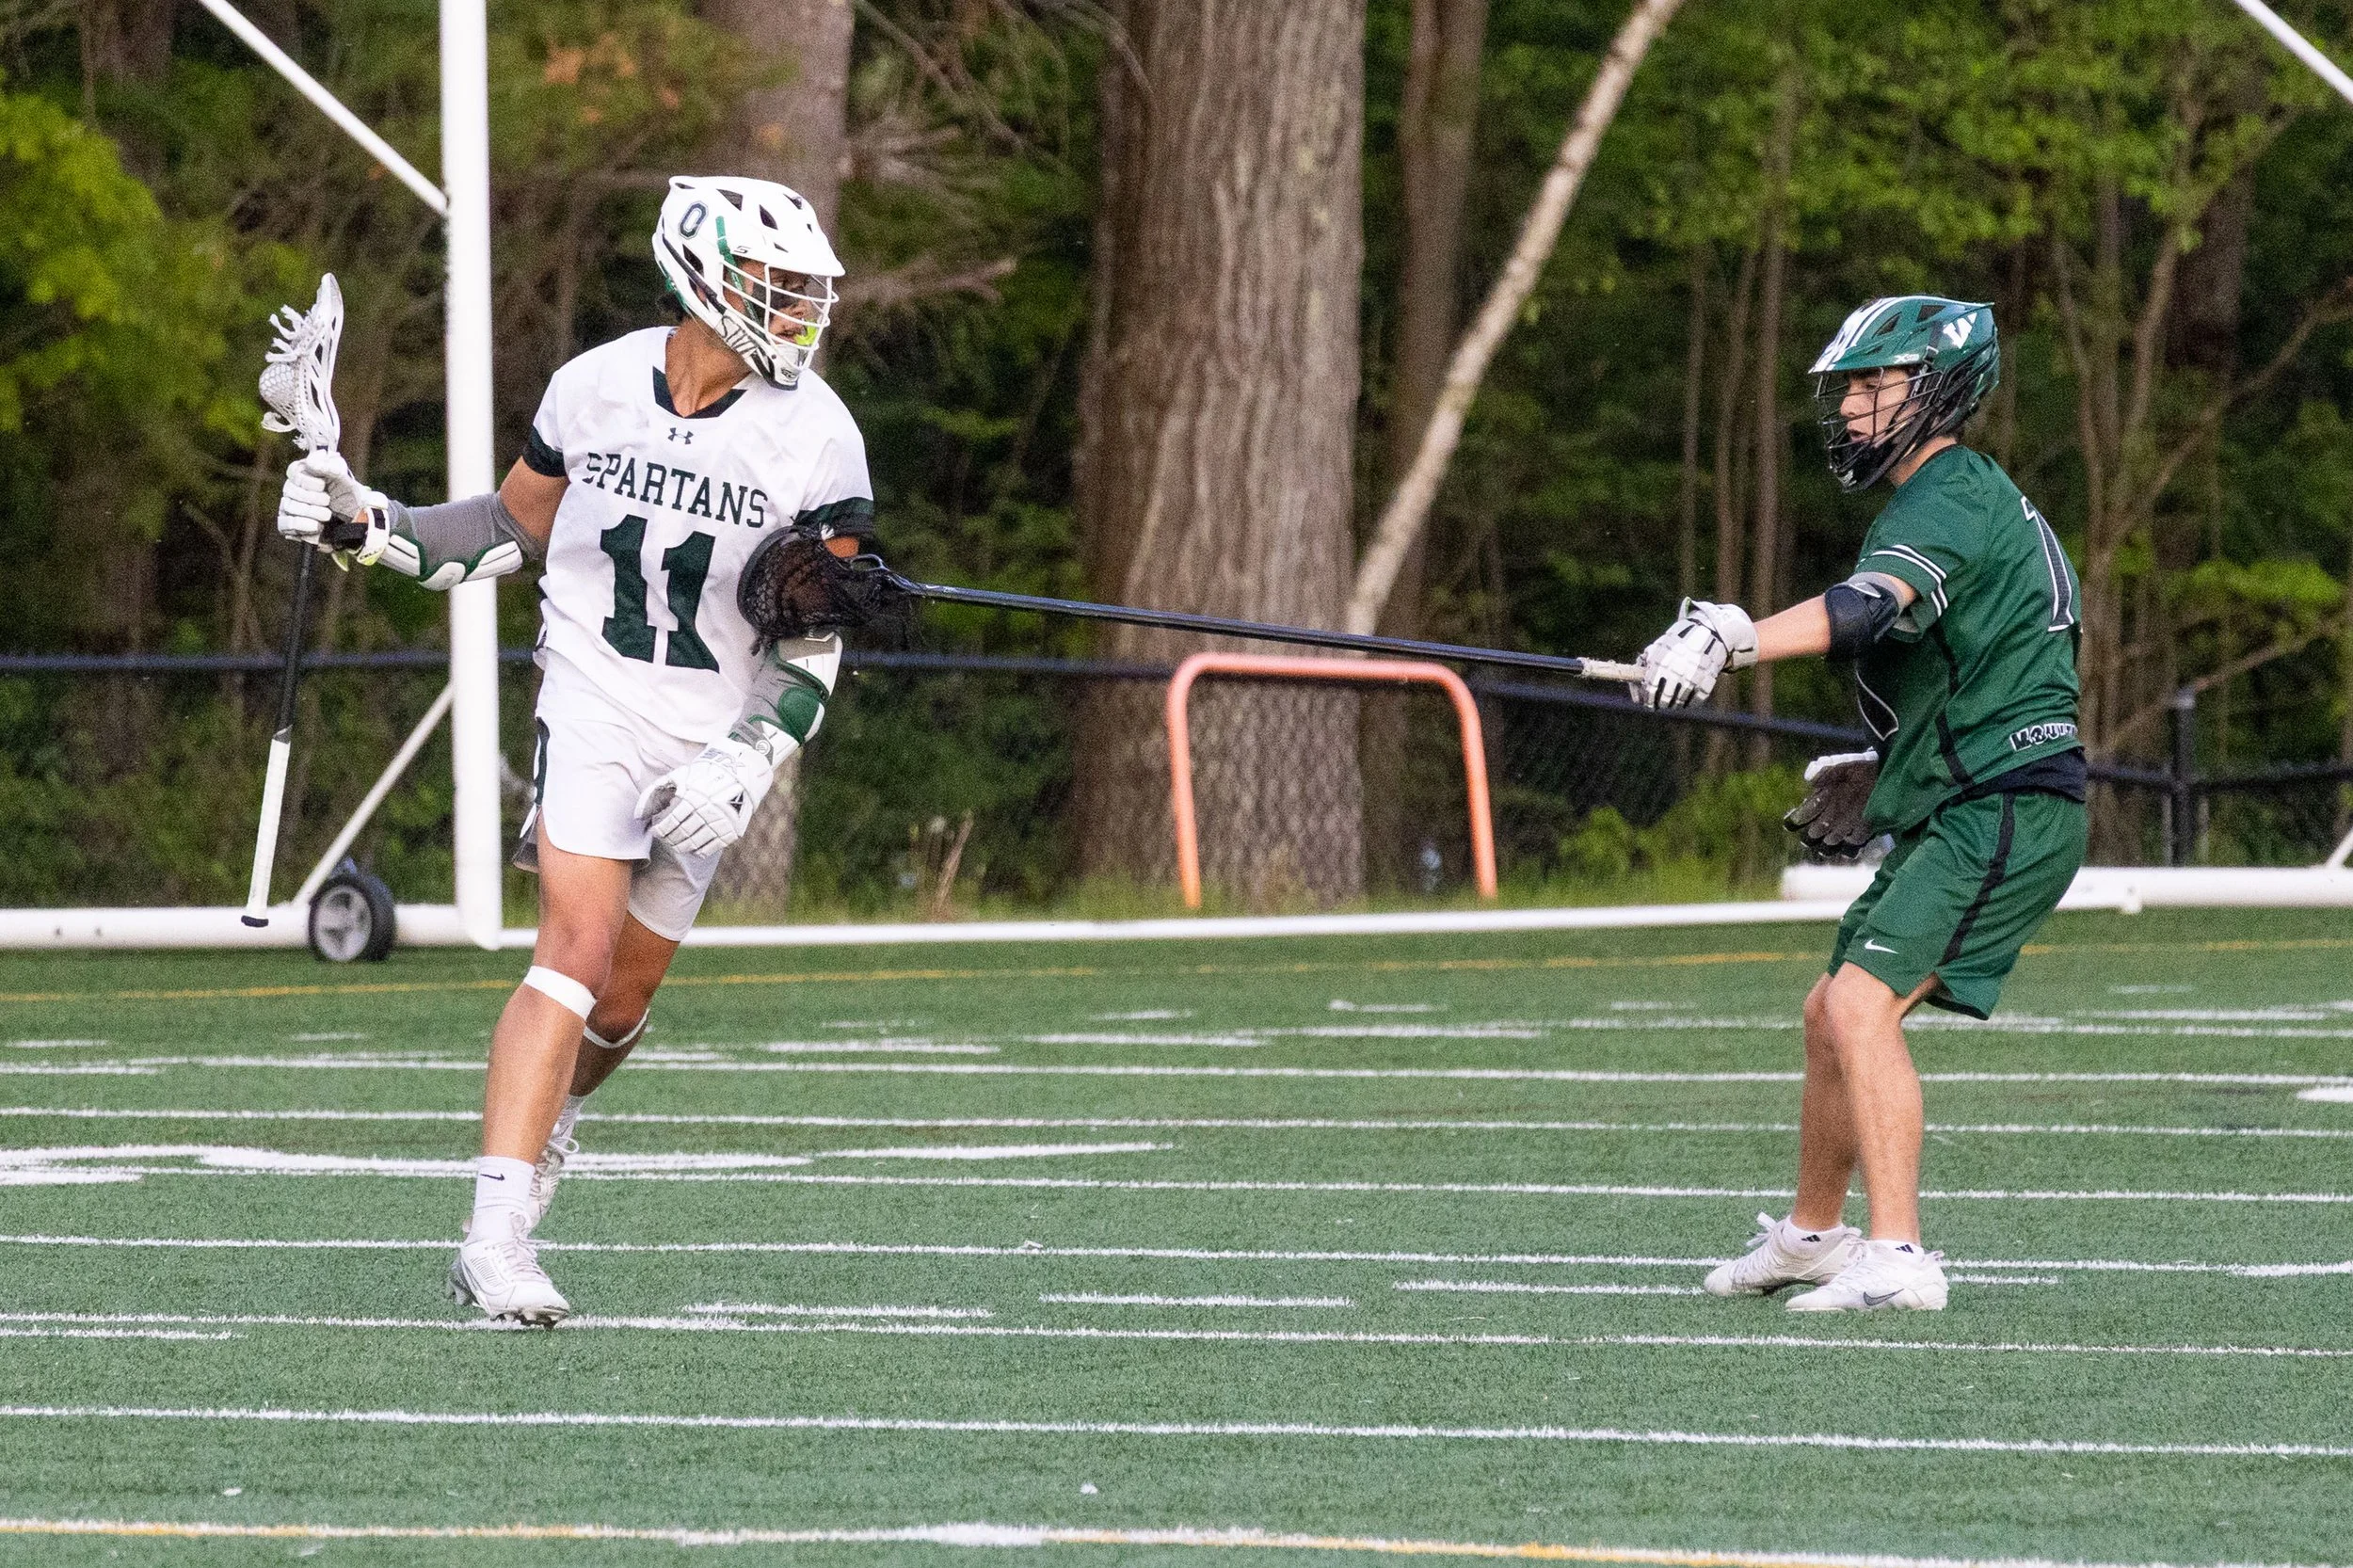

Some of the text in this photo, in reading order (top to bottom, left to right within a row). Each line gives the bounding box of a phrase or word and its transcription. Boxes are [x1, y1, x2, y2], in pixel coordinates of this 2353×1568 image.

[1943, 312, 1977, 349] W
[582, 452, 768, 528] SPARTANS
[600, 514, 720, 674] 11
